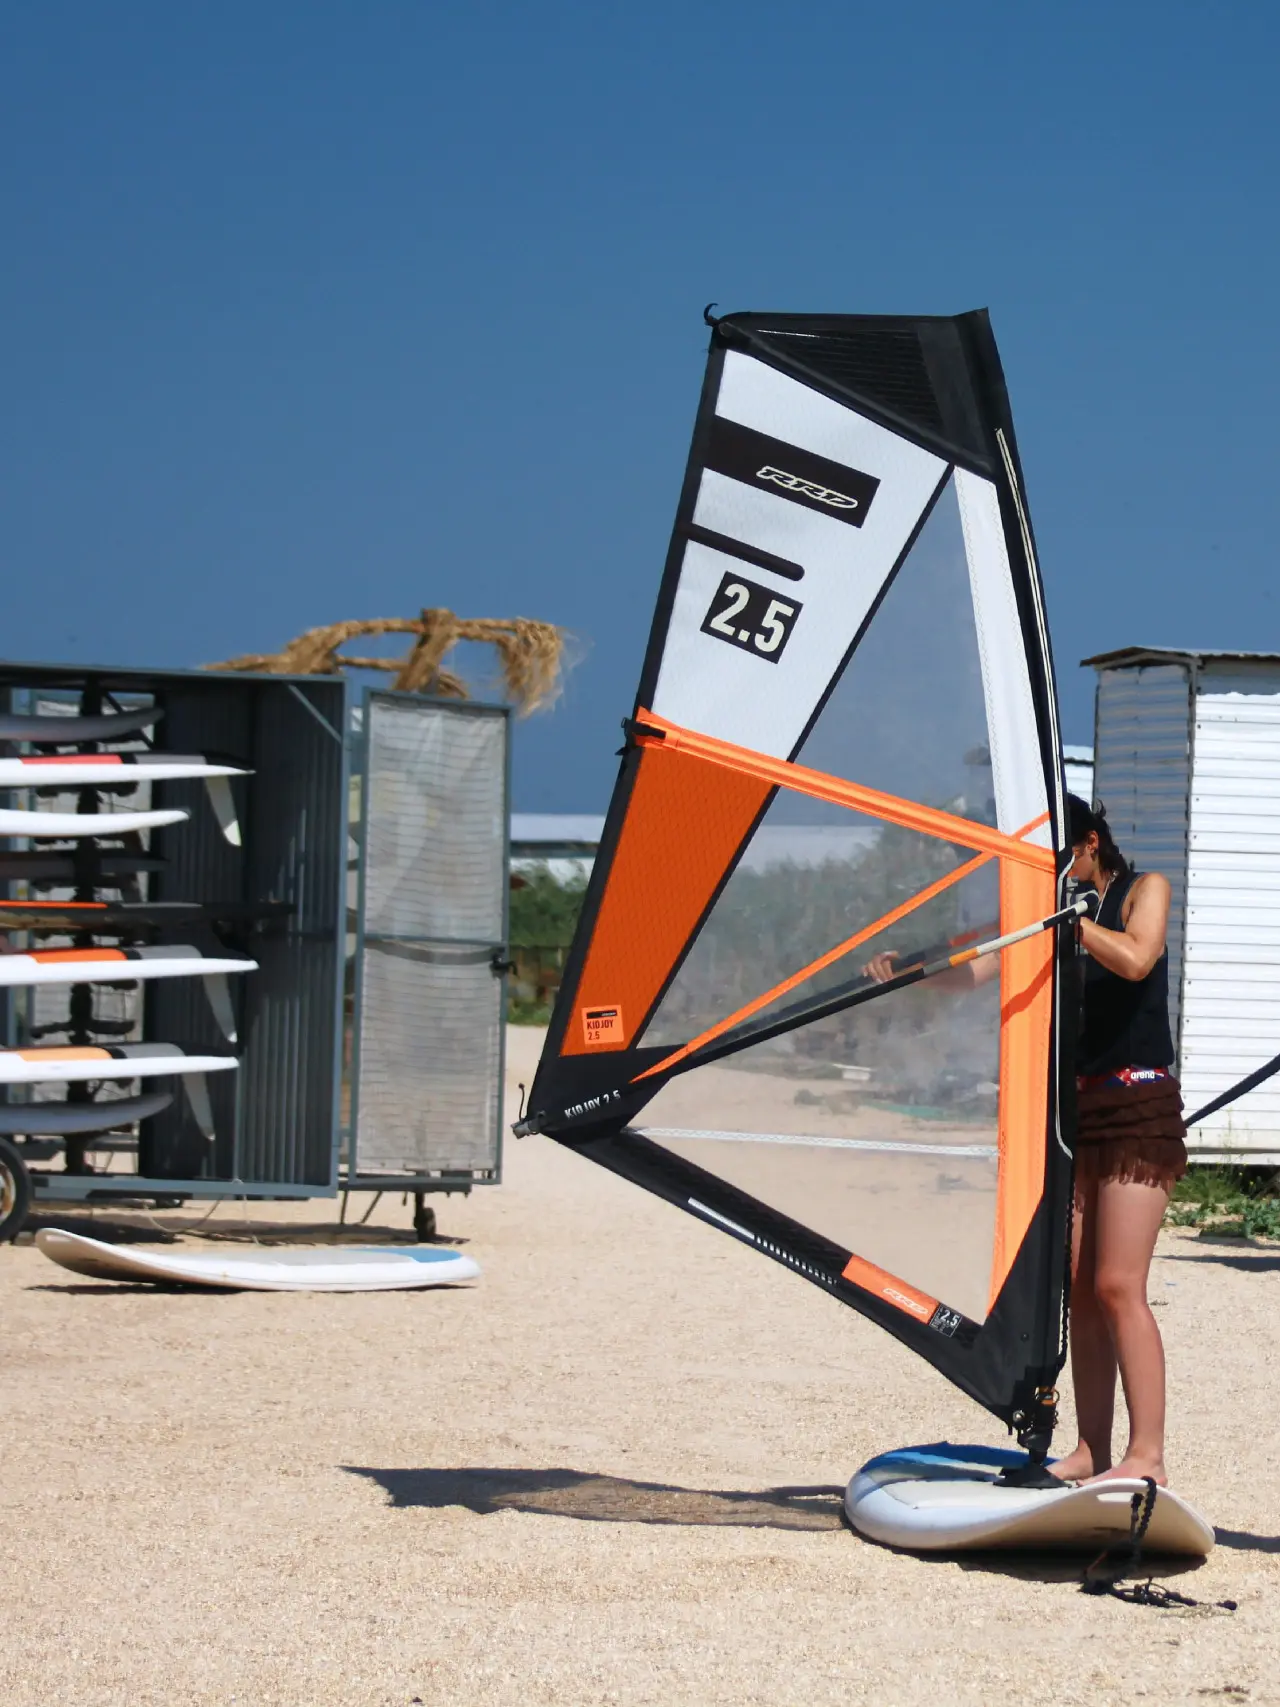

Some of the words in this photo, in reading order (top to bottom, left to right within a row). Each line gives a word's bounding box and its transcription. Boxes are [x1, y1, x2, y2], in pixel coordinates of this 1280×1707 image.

[756, 465, 858, 509] RRD
[709, 583, 795, 653] 2.5
[587, 1031, 600, 1041] 2.5
[1130, 1070, 1155, 1080] arena
[940, 1309, 960, 1328] 2.5
